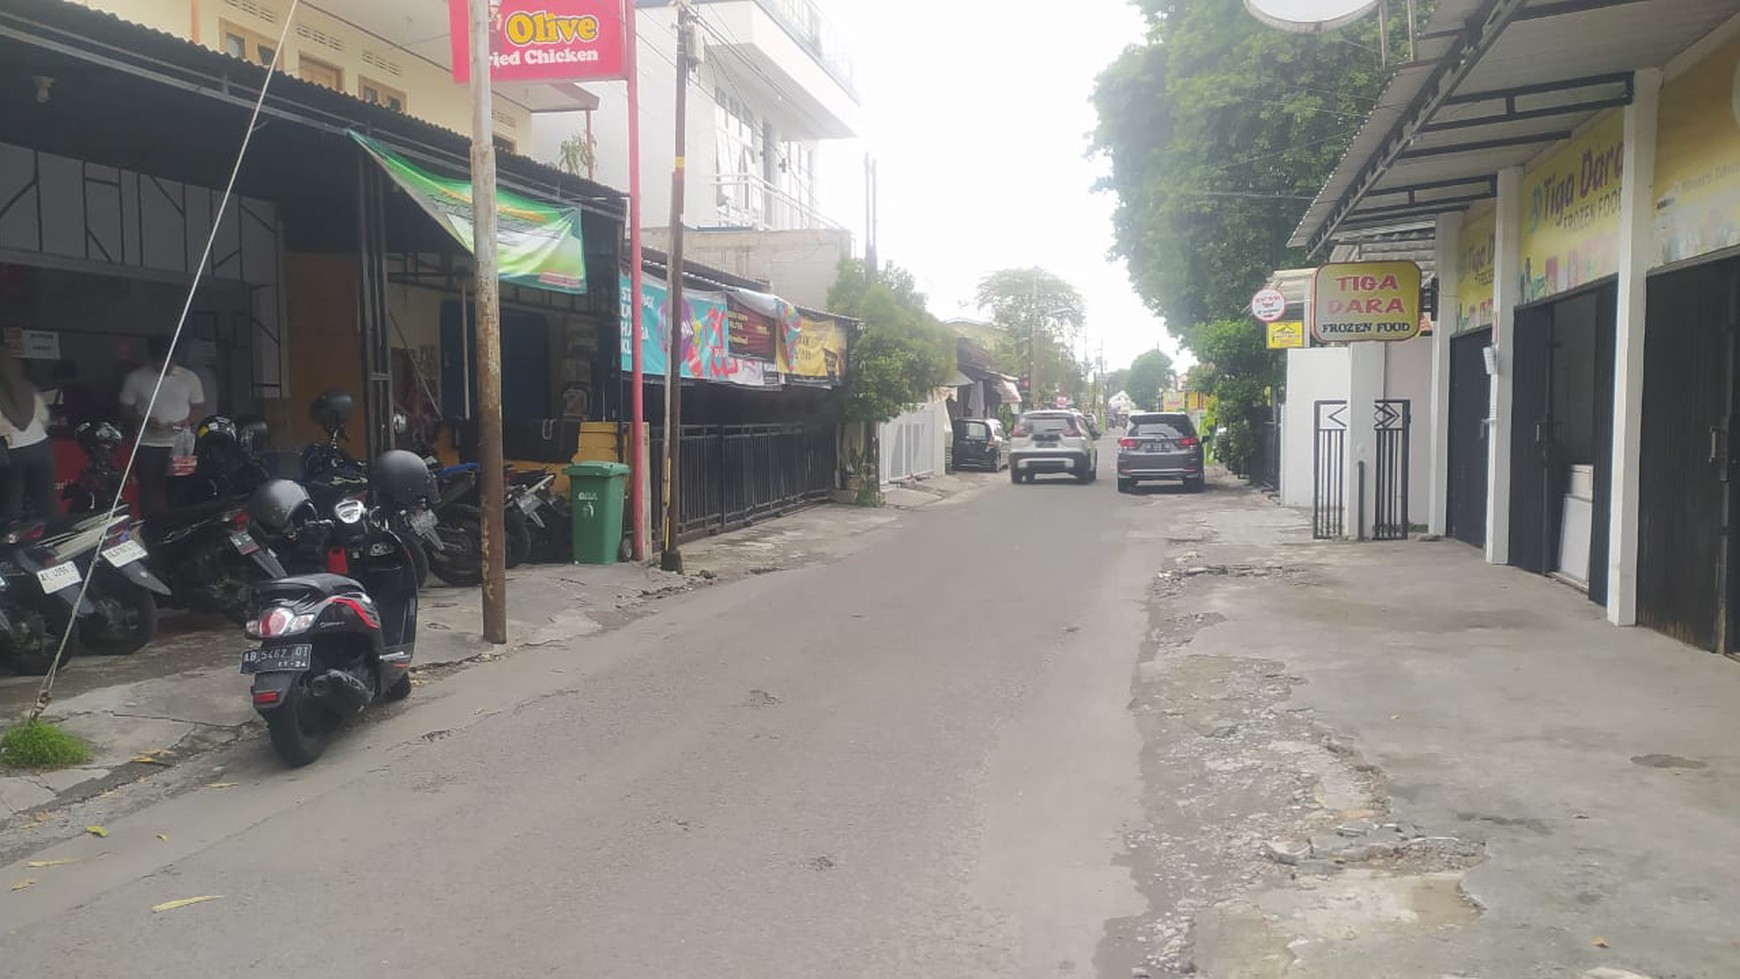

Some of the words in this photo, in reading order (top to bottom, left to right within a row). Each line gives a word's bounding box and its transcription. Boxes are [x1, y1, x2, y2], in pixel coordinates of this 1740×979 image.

[506, 12, 598, 45] Olive
[489, 51, 521, 67] ried
[524, 48, 599, 65] Chicken
[1543, 171, 1575, 226] Tiga
[1335, 274, 1399, 292] TIGA
[1327, 298, 1405, 314] DARA
[1322, 322, 1373, 333] FROZEN
[1377, 322, 1411, 332] FOOD
